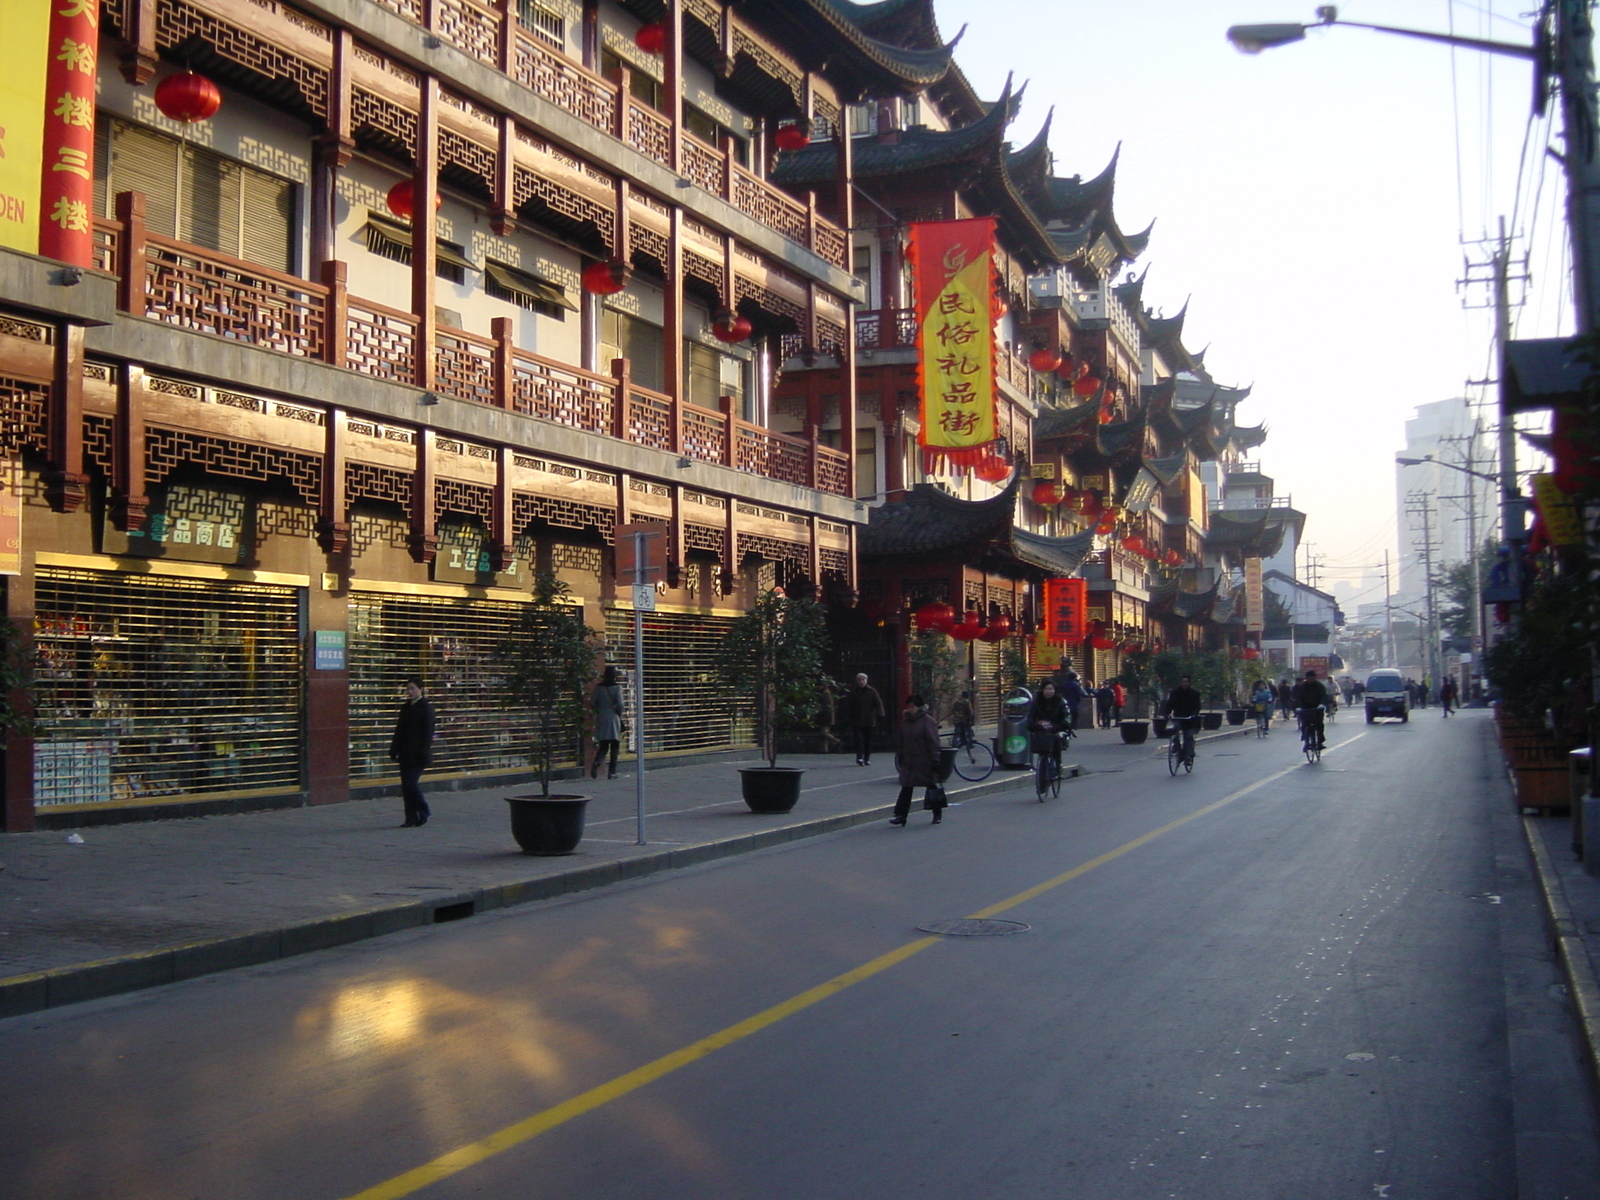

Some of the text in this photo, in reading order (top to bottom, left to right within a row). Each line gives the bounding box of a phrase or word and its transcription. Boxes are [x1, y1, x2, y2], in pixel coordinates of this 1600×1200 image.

[936, 293, 981, 436] 民俗礼品街
